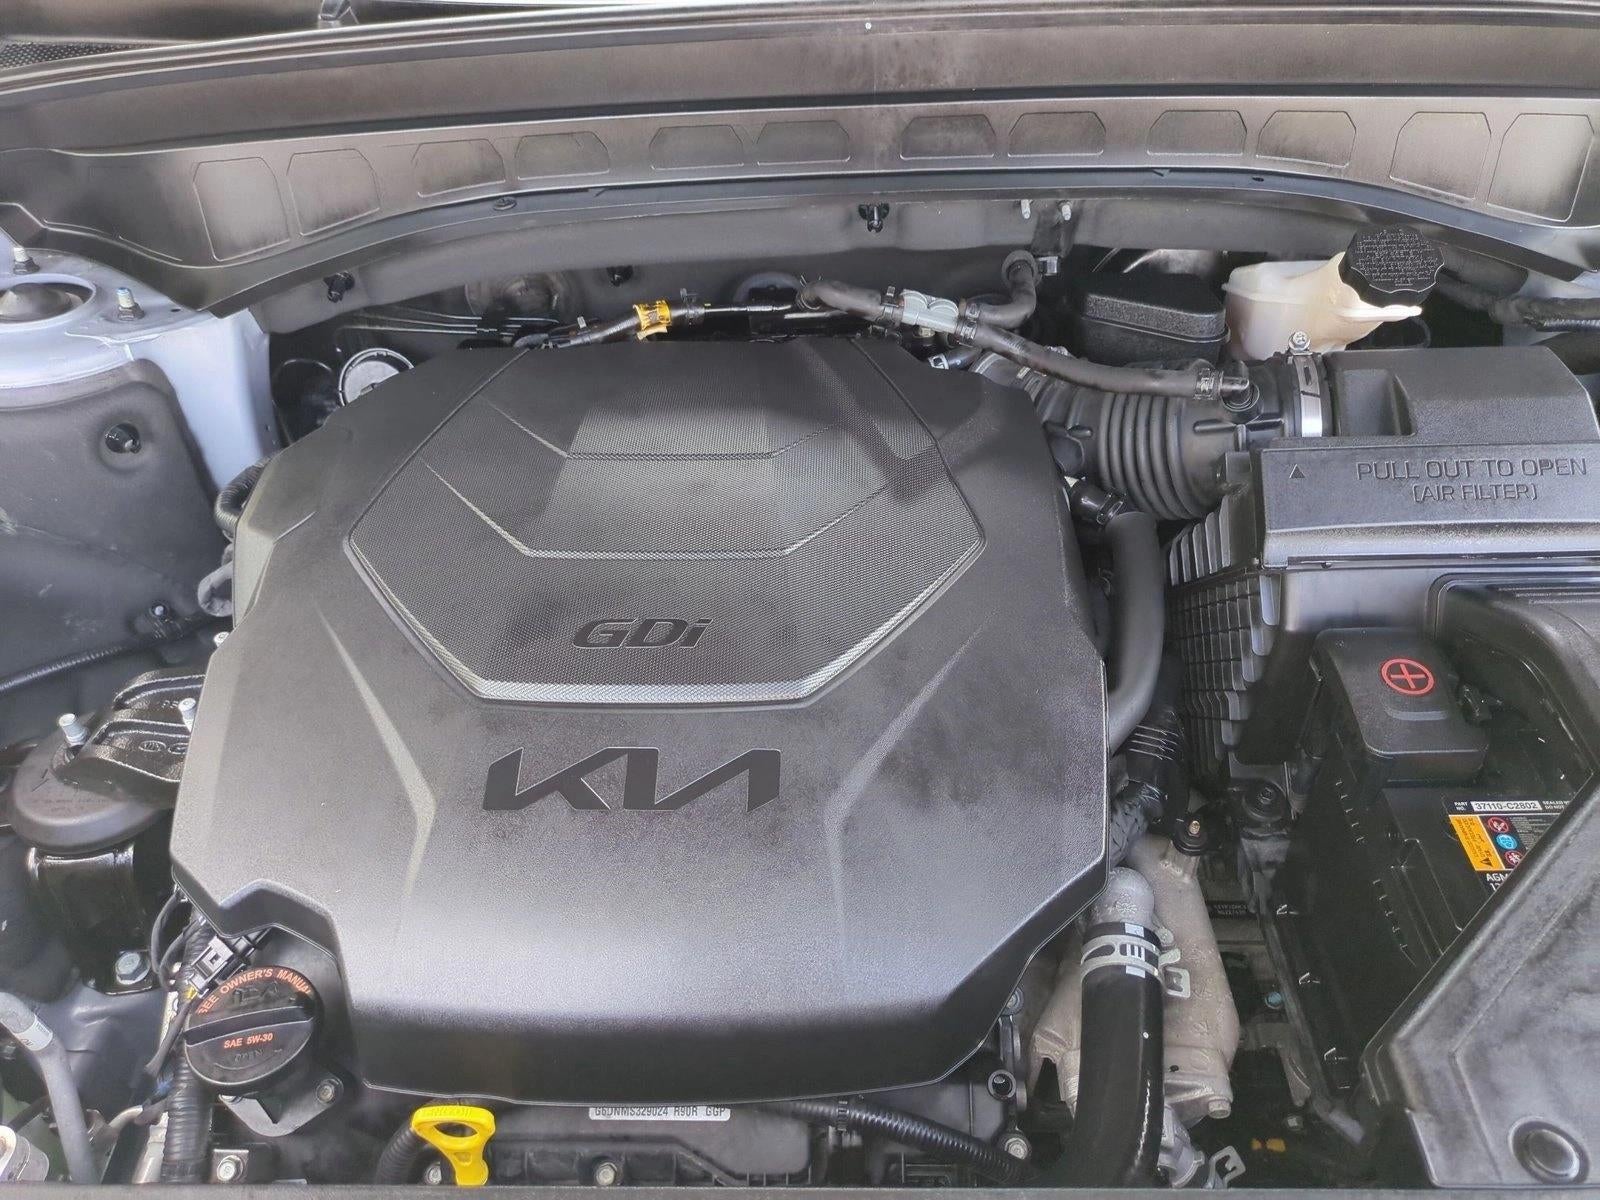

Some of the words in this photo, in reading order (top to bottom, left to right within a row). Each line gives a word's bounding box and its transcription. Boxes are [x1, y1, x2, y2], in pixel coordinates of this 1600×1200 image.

[1356, 459, 1419, 481] PULL
[1425, 459, 1474, 480] OUT
[1481, 458, 1514, 478] TO
[1520, 457, 1587, 476] OPEN
[572, 618, 714, 649] GDi
[1475, 802, 1538, 810] 37110-C2802
[197, 995, 220, 1016] SEE
[219, 968, 273, 994] OWNER'S
[224, 1035, 243, 1049] SAE
[246, 1033, 273, 1045] 5W-30
